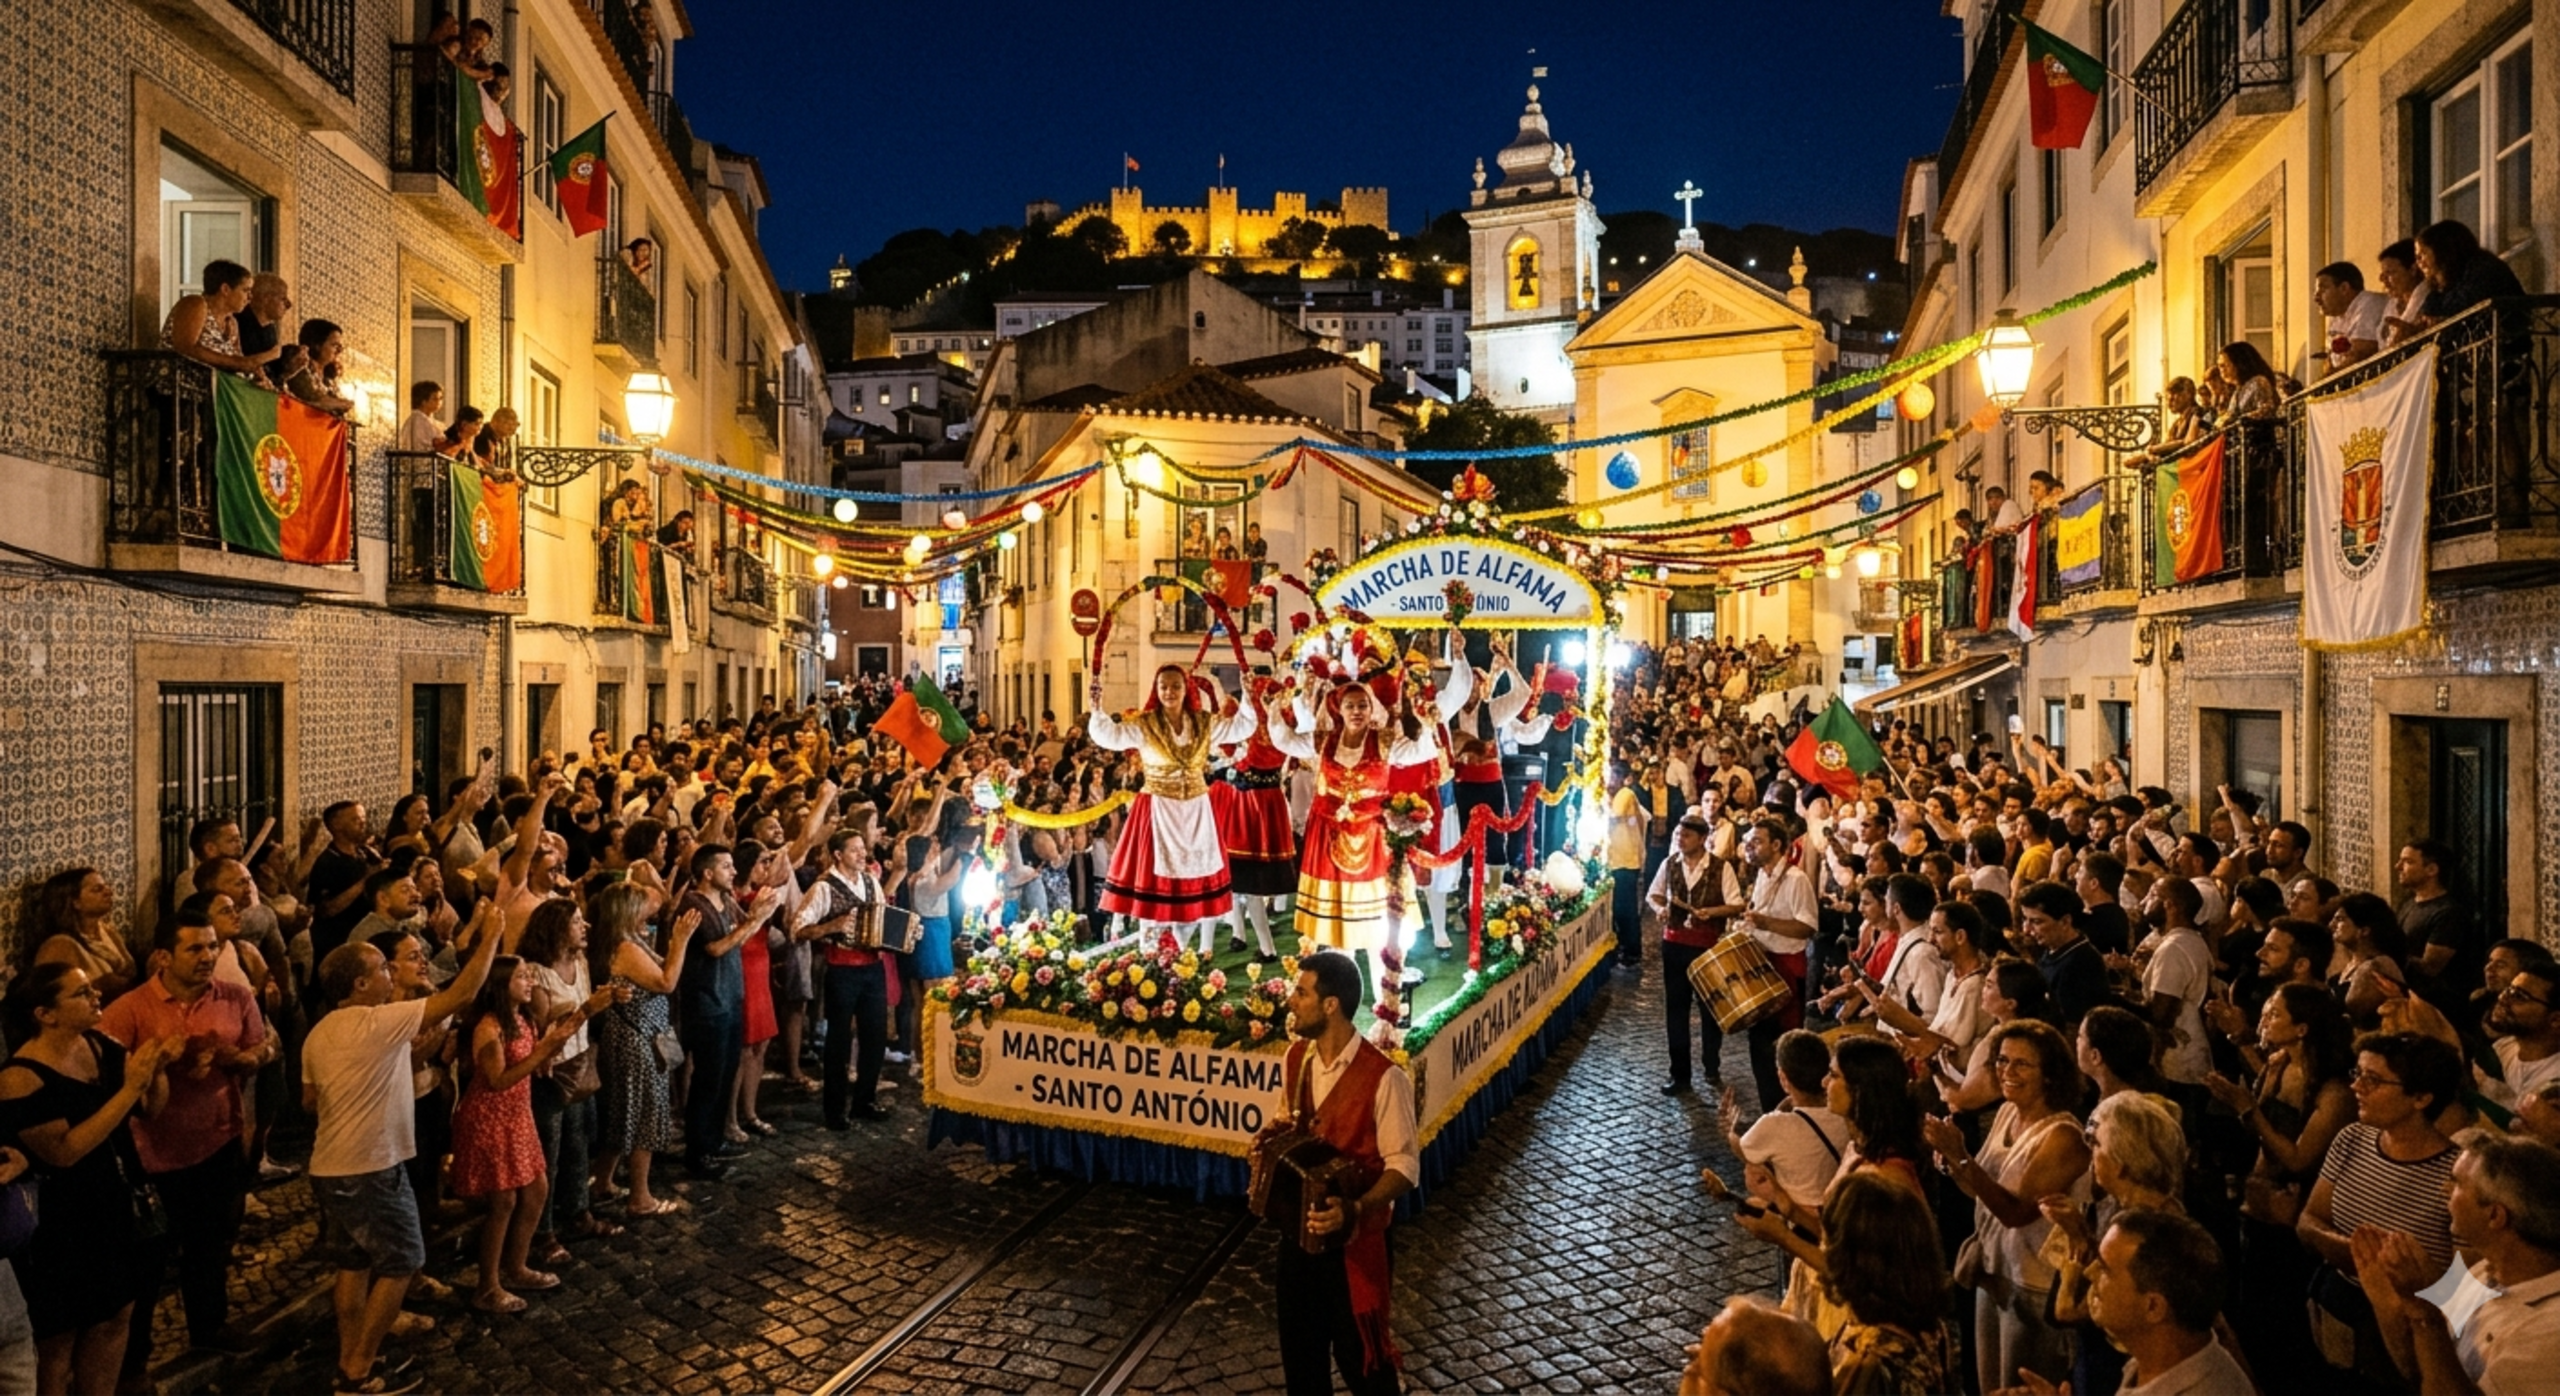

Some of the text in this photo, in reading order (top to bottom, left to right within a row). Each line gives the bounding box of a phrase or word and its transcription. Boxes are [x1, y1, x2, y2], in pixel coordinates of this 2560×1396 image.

[1341, 550, 1567, 613] MARCHA DE ALFAMA
[1399, 595, 1444, 611] SANTO
[1002, 1029, 1116, 1072] MARCHA
[1124, 1046, 1161, 1078] DE
[1169, 1051, 1283, 1092] ALFAMA
[1032, 1074, 1123, 1113] SANTO
[1131, 1088, 1264, 1134] ANTÓNIO
